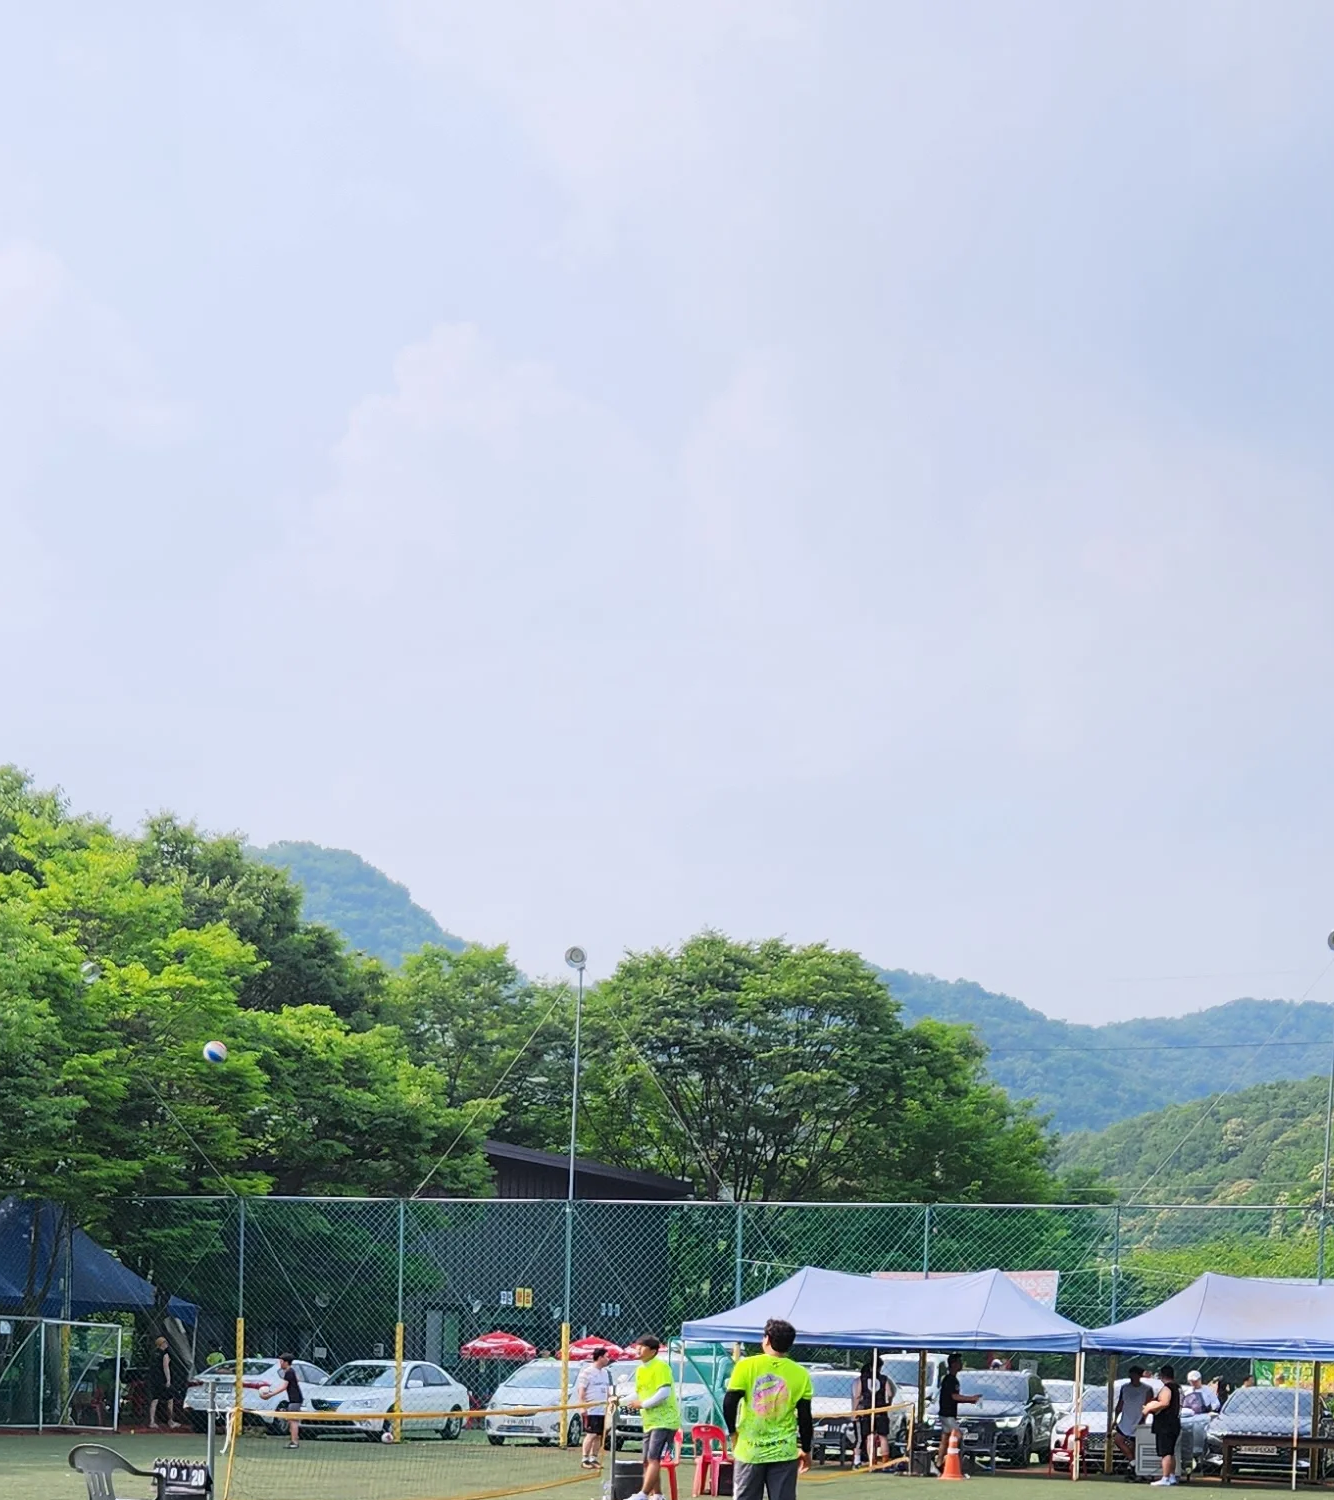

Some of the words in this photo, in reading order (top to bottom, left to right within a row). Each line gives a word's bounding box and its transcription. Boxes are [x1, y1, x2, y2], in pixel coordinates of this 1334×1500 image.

[170, 1467, 178, 1479] 0
[181, 1469, 187, 1481] 1
[191, 1469, 205, 1486] 20
